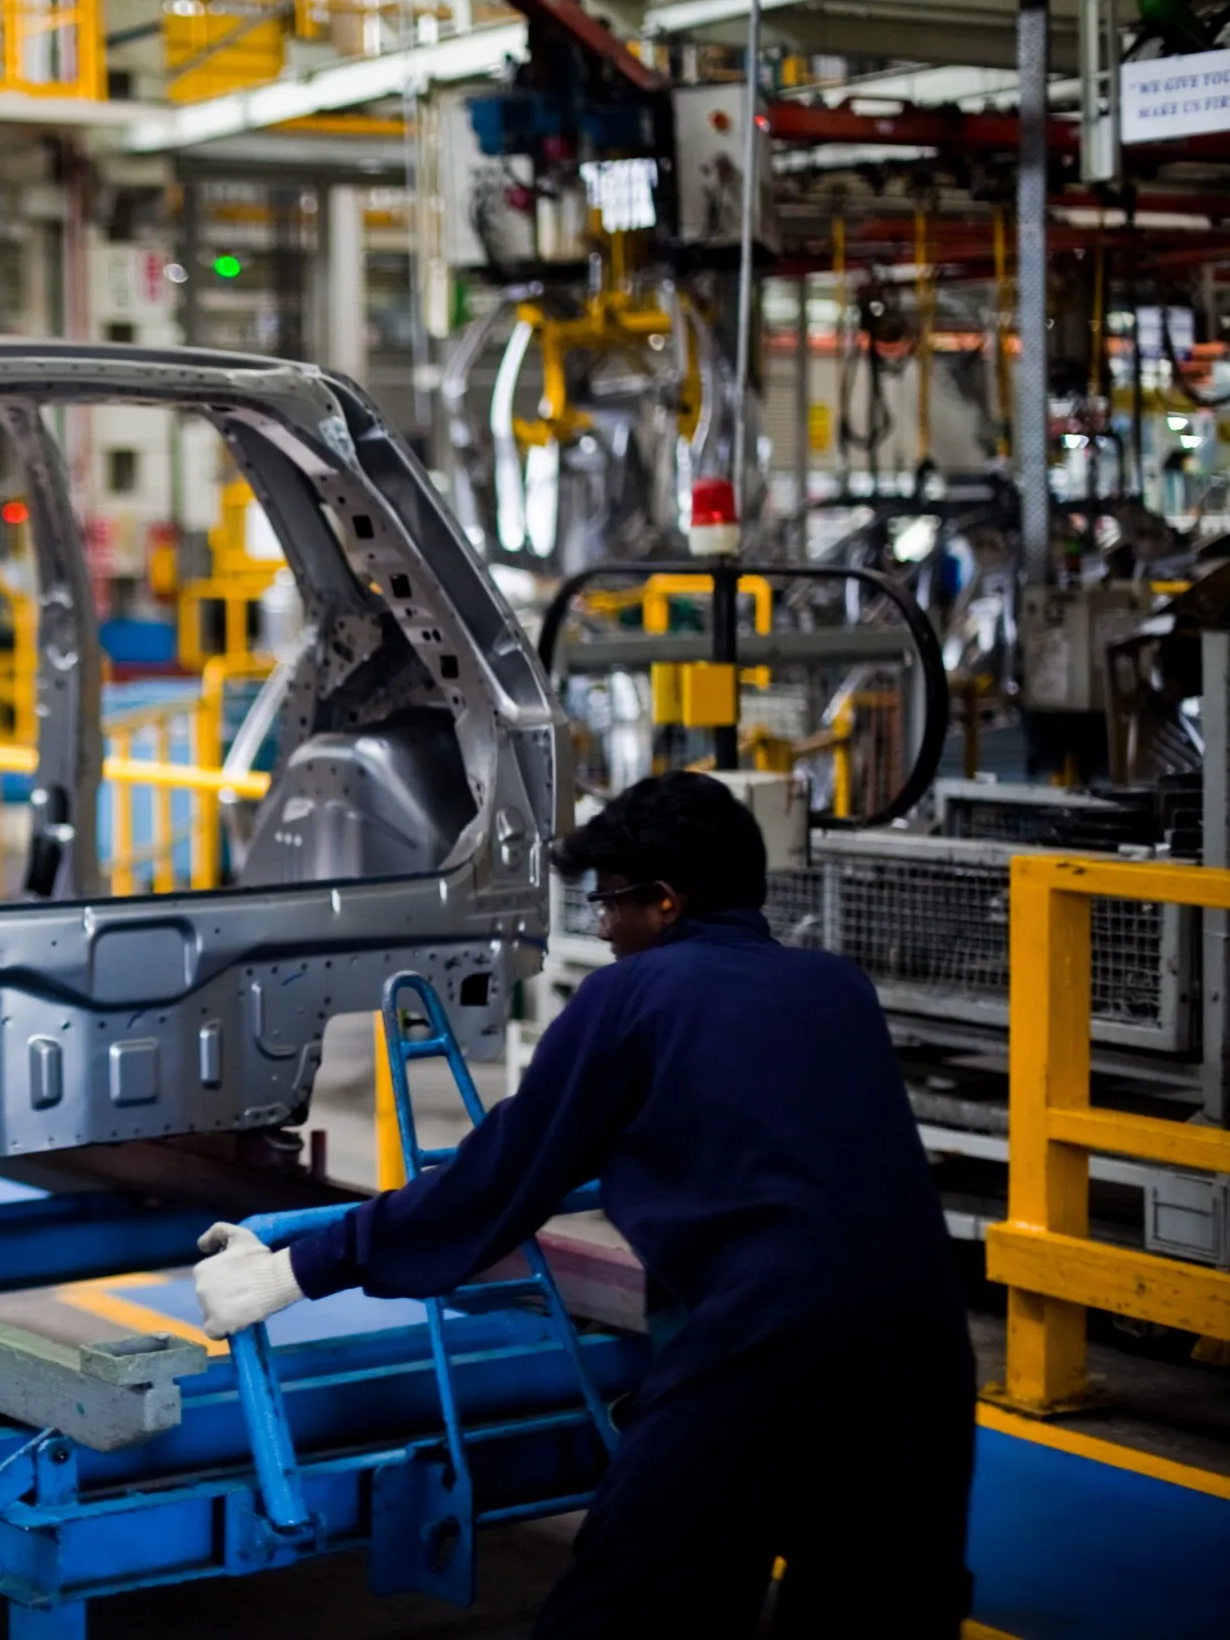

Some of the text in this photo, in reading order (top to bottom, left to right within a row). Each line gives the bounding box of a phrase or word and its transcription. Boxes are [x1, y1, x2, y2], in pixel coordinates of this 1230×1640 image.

[1164, 75, 1198, 91] GIVE
[1138, 102, 1178, 118] MAKE
[1183, 99, 1200, 114] US
